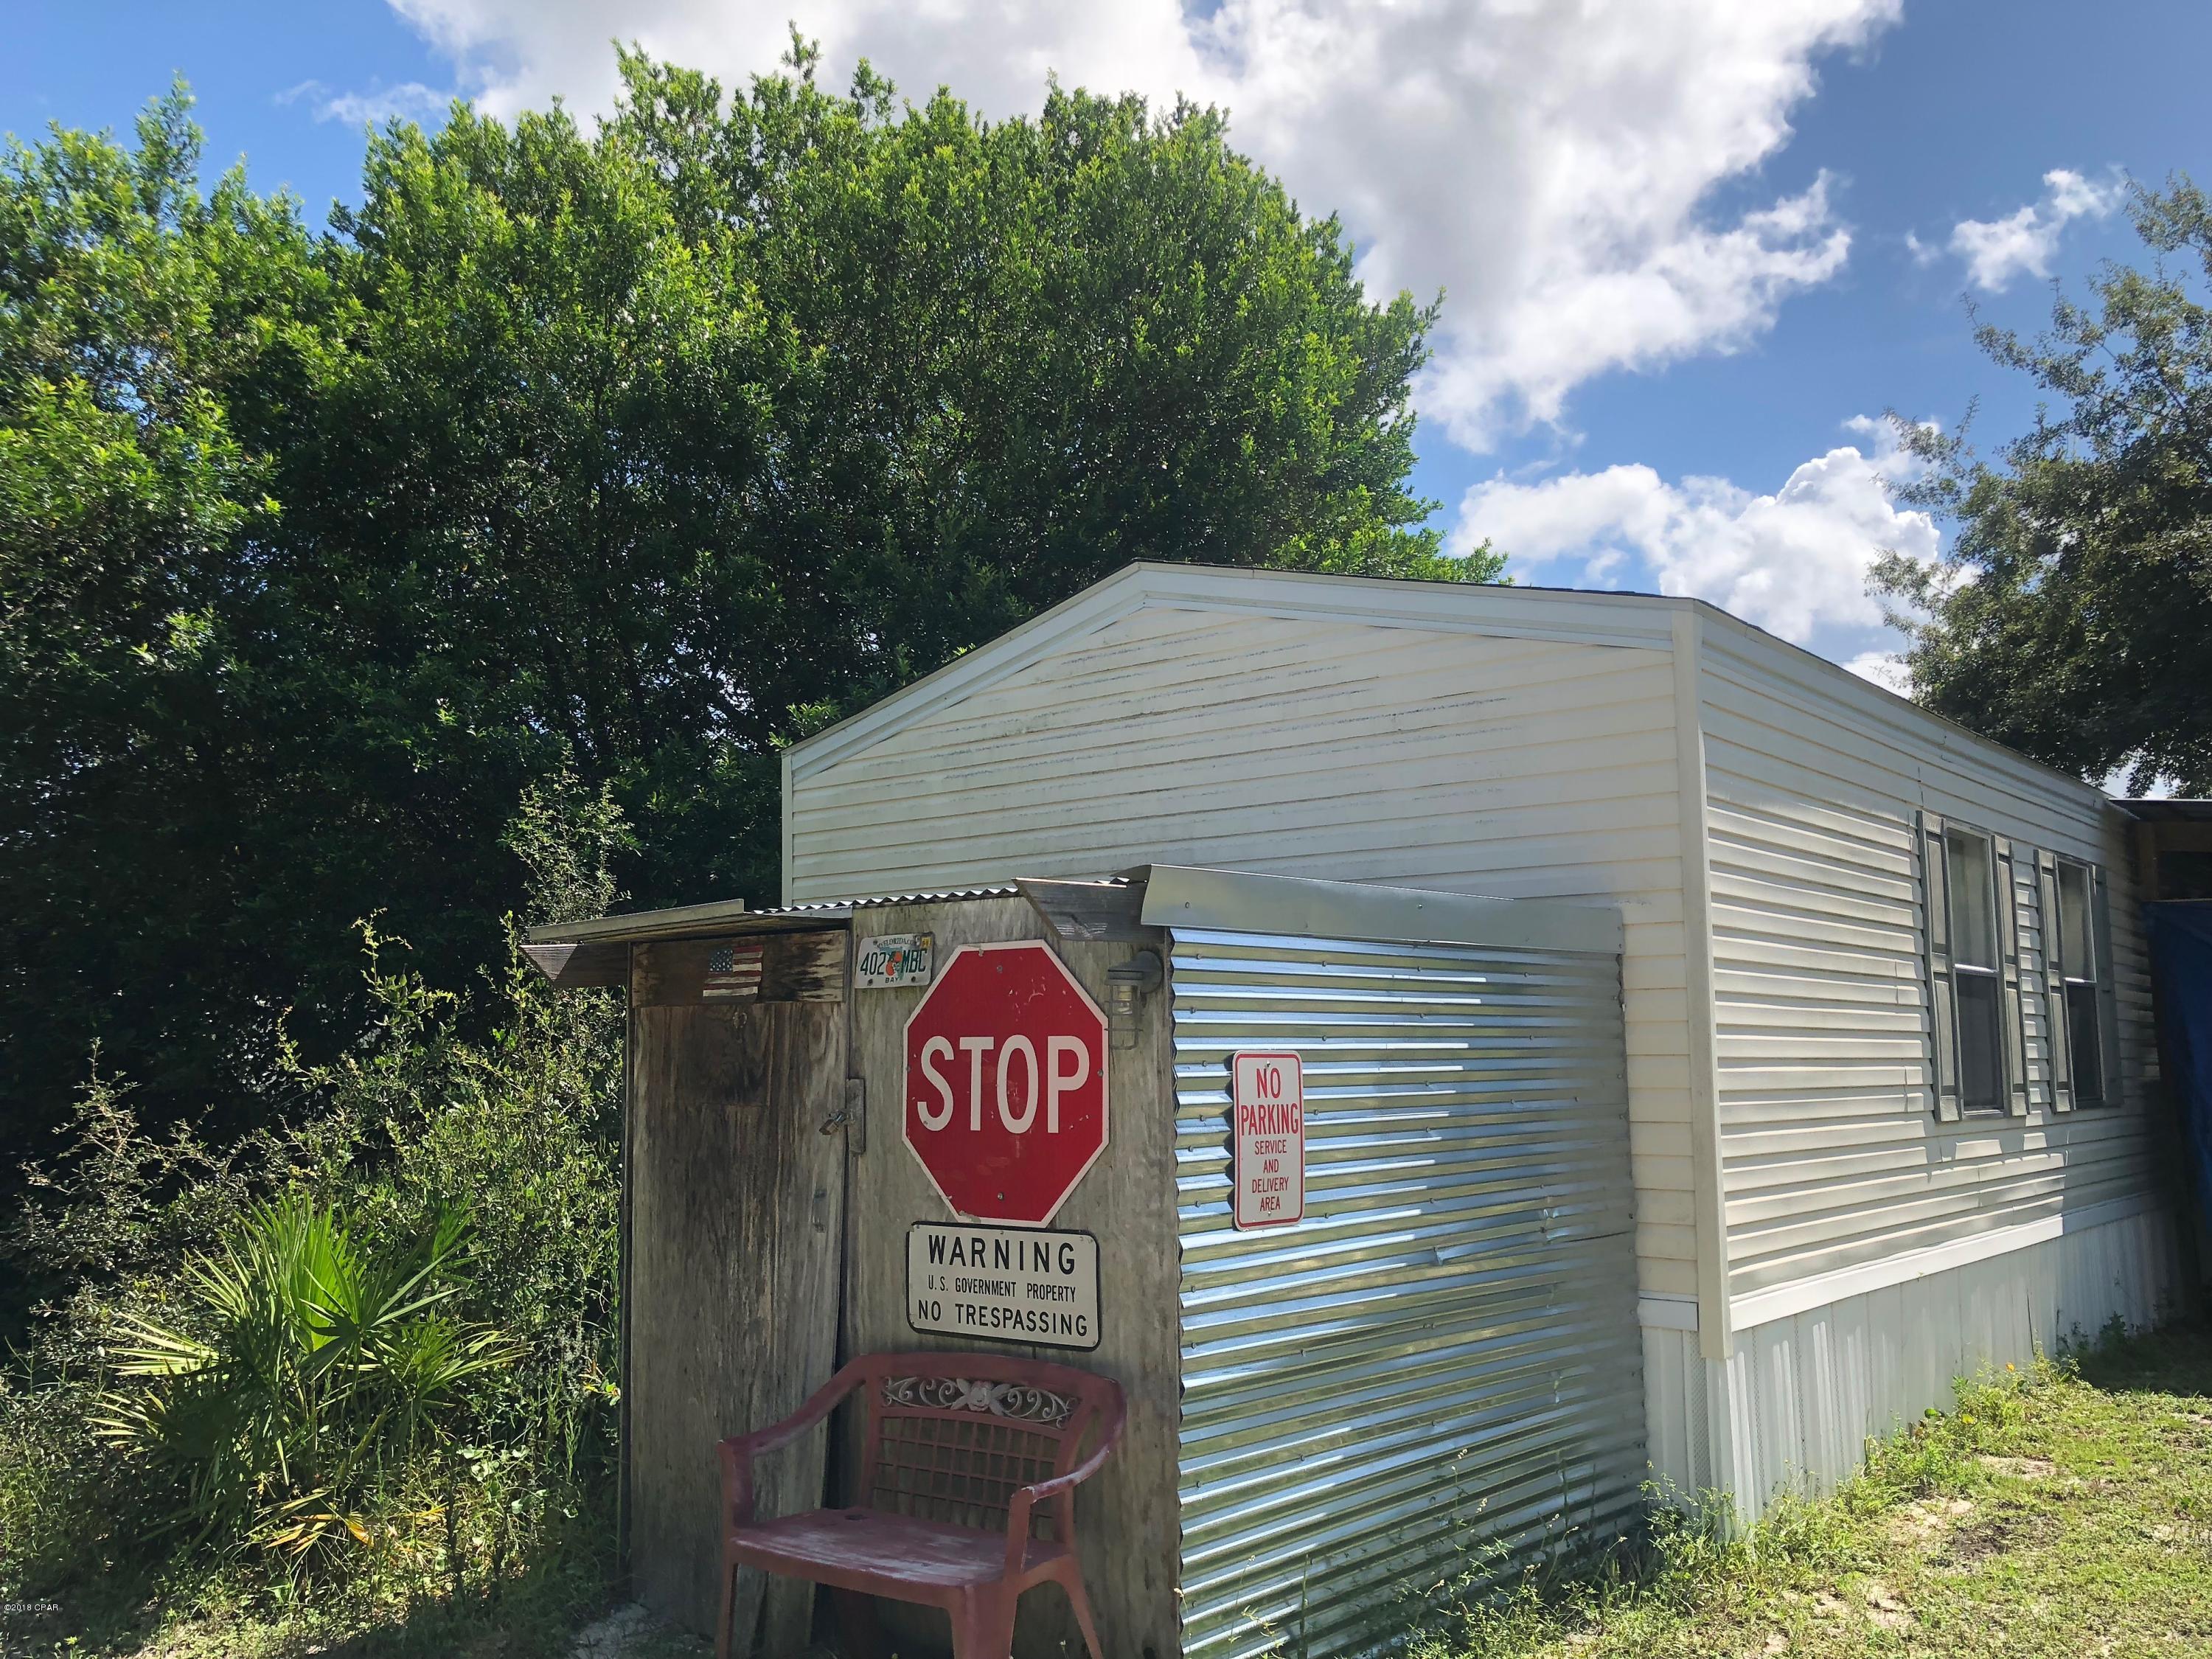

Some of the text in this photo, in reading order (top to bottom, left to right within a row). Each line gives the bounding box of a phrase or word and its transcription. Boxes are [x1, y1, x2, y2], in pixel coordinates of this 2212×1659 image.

[860, 948, 928, 975] 402 MBC
[917, 1034, 1090, 1134] STOP
[1256, 1068, 1281, 1099] NO
[1241, 1102, 1299, 1136] PARKING
[1254, 1139, 1287, 1155] SERVICE
[1263, 1158, 1279, 1174] AND
[1252, 1177, 1290, 1194] DELIVERY
[1259, 1196, 1281, 1212] AREA
[928, 1234, 1075, 1275] WARNING
[928, 1274, 1076, 1303] U.S. GOVERNMENT PROPERTY
[918, 1299, 1088, 1337] NO TRESPASSING
